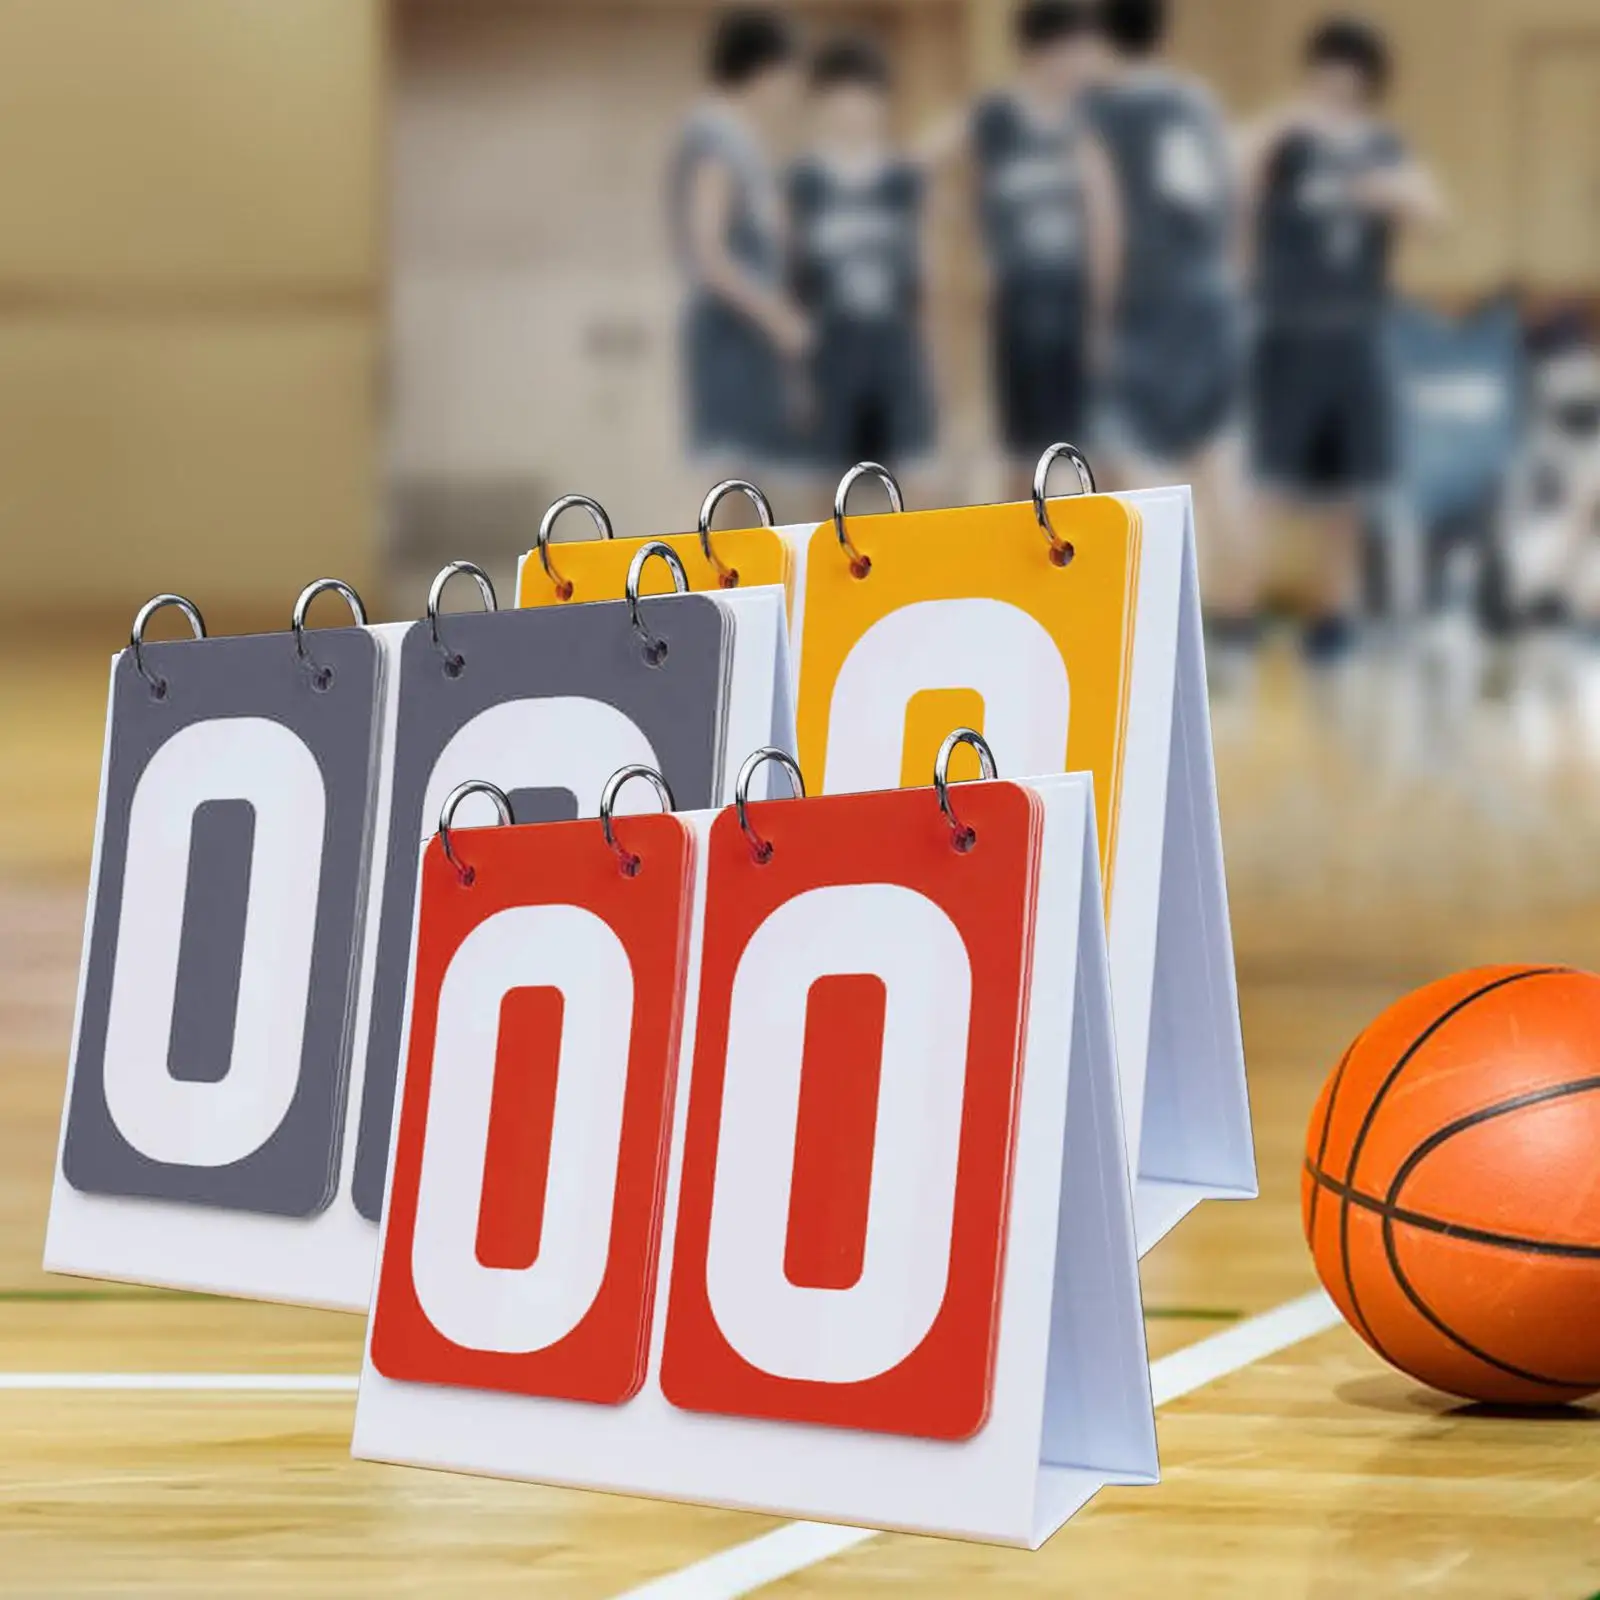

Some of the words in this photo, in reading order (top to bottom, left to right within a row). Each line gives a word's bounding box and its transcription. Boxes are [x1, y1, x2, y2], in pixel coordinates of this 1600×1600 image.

[104, 717, 326, 1166] 0
[412, 904, 634, 1353] 0
[707, 884, 971, 1382] 0
